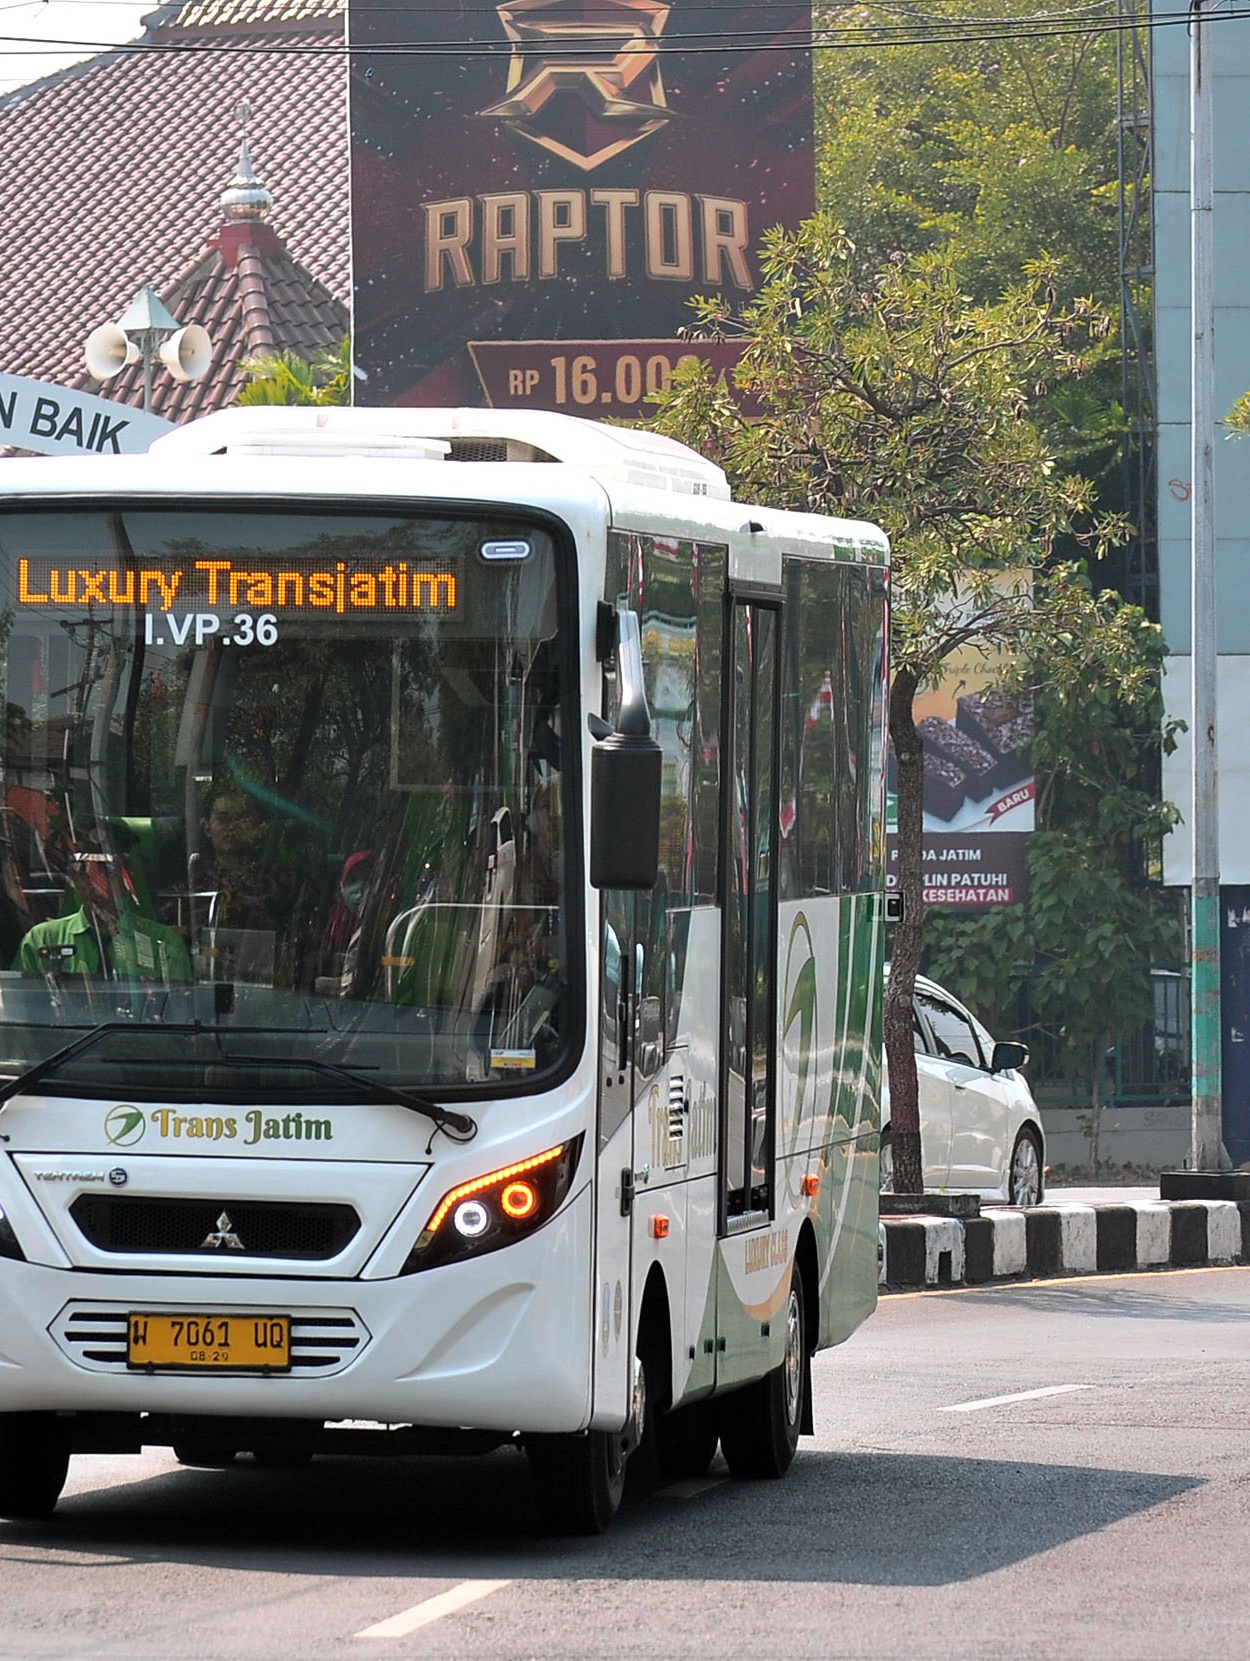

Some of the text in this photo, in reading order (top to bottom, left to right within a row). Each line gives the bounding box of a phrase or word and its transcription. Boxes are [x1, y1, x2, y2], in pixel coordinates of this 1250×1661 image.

[421, 188, 754, 292] RAPTOR
[509, 354, 699, 404] RP 16.00
[29, 397, 131, 455] BAIK
[18, 558, 457, 614] Luxury Transjatim
[997, 788, 1030, 813] BARU
[939, 849, 982, 861] JATIM
[950, 873, 1007, 886] PATUHI
[151, 1108, 334, 1146] Trans Jatim
[132, 1320, 284, 1349] W 7061 UQ
